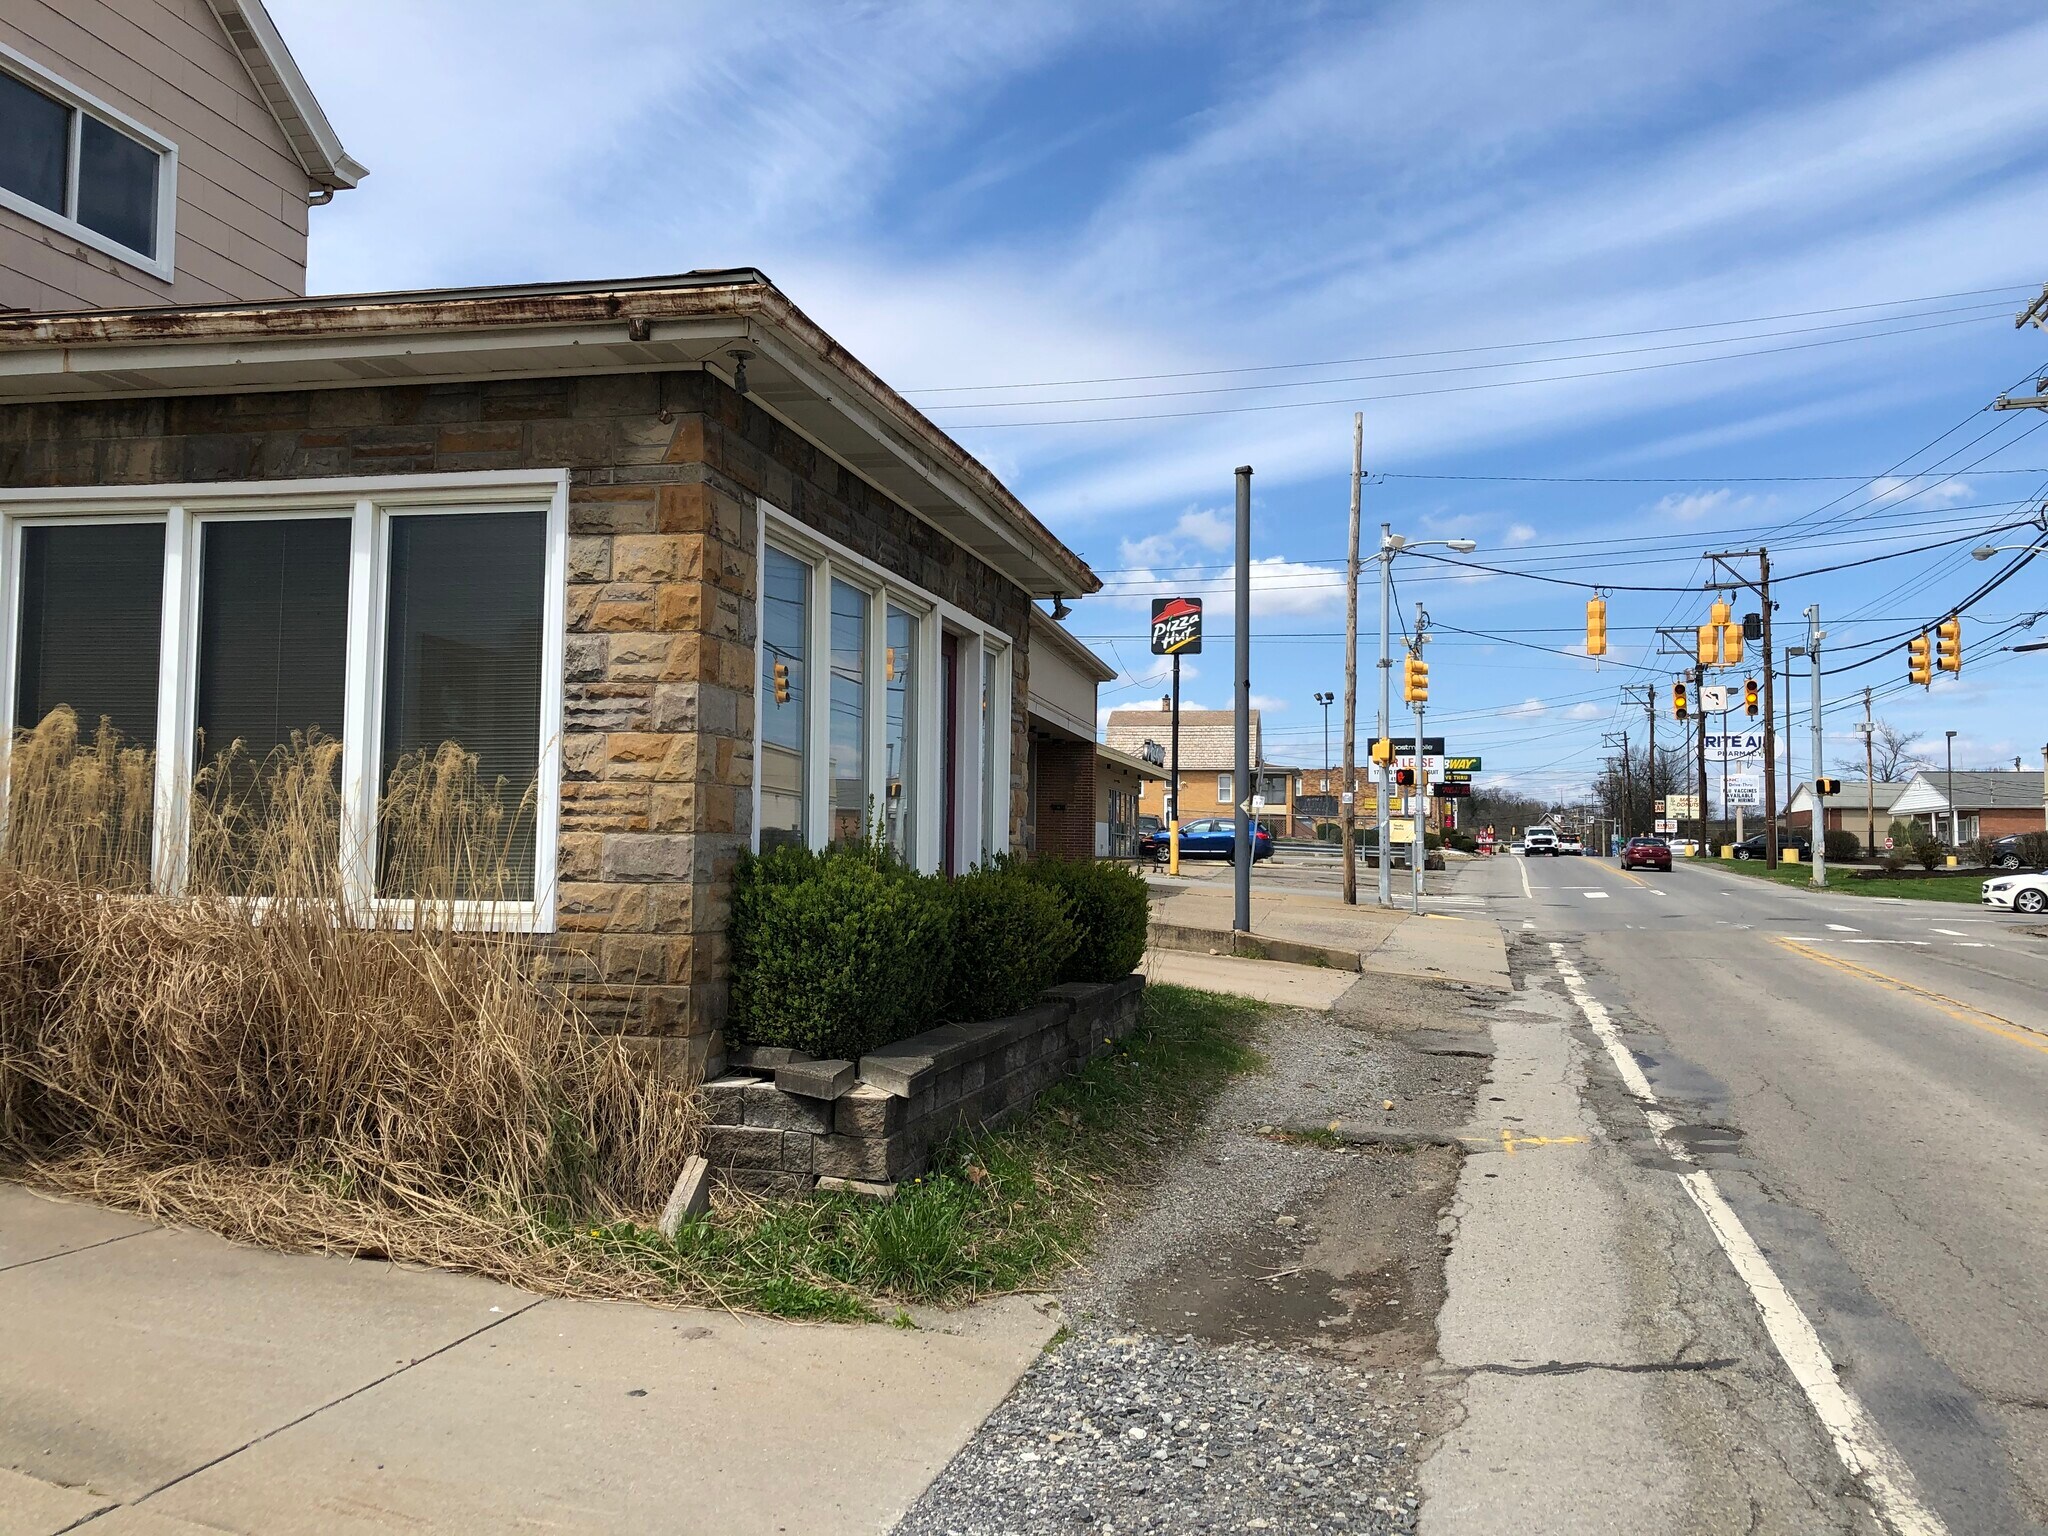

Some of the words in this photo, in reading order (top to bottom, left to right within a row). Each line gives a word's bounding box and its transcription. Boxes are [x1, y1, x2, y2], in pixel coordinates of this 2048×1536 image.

[1152, 614, 1200, 645] Pizza
[1161, 626, 1197, 649] Hut
[1705, 735, 1742, 748] RITE
[1745, 735, 1766, 748] AI
[1402, 757, 1434, 768] LESE
[1444, 758, 1476, 769] BWAY
